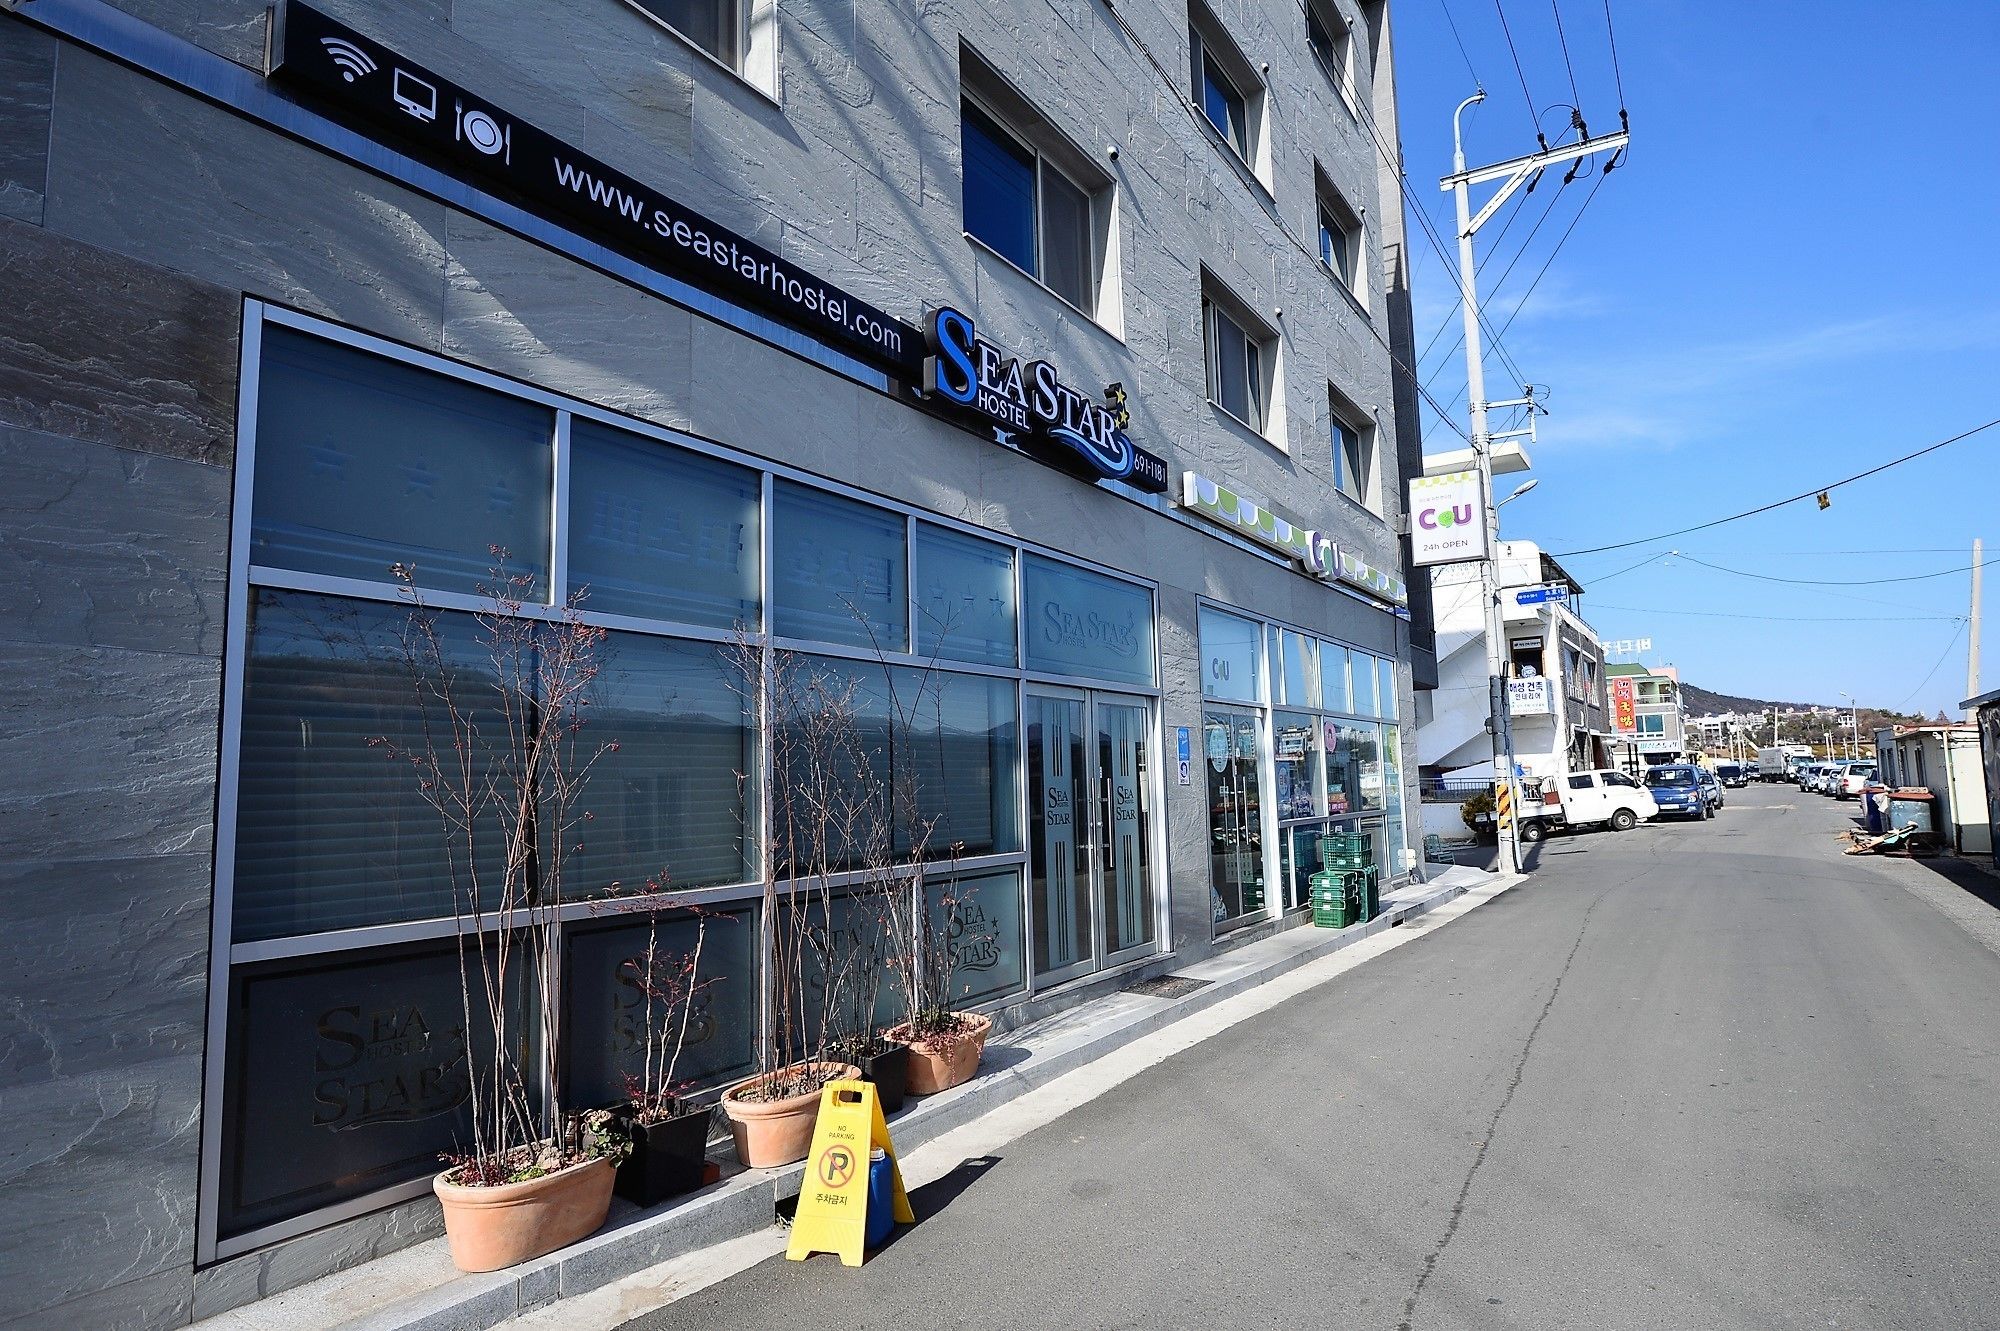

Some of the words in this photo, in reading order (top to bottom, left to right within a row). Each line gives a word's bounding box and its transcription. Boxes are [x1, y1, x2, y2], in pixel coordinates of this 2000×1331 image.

[554, 157, 901, 353] www.seastarhostel.com
[936, 309, 1029, 408] SEA
[1035, 362, 1120, 454] STAR
[978, 389, 1030, 431] HOSTEL
[1134, 453, 1166, 483] 691-1181
[1424, 543, 1440, 552] 24h
[1442, 539, 1469, 550] OPEN
[1048, 787, 1069, 808] SEA
[1117, 785, 1134, 805] SEA
[1047, 810, 1071, 825] STAR
[1116, 807, 1136, 821] STAR
[314, 1005, 430, 1073] SEA
[828, 1132, 855, 1141] PARKING
[816, 1193, 848, 1206] 주차금지
